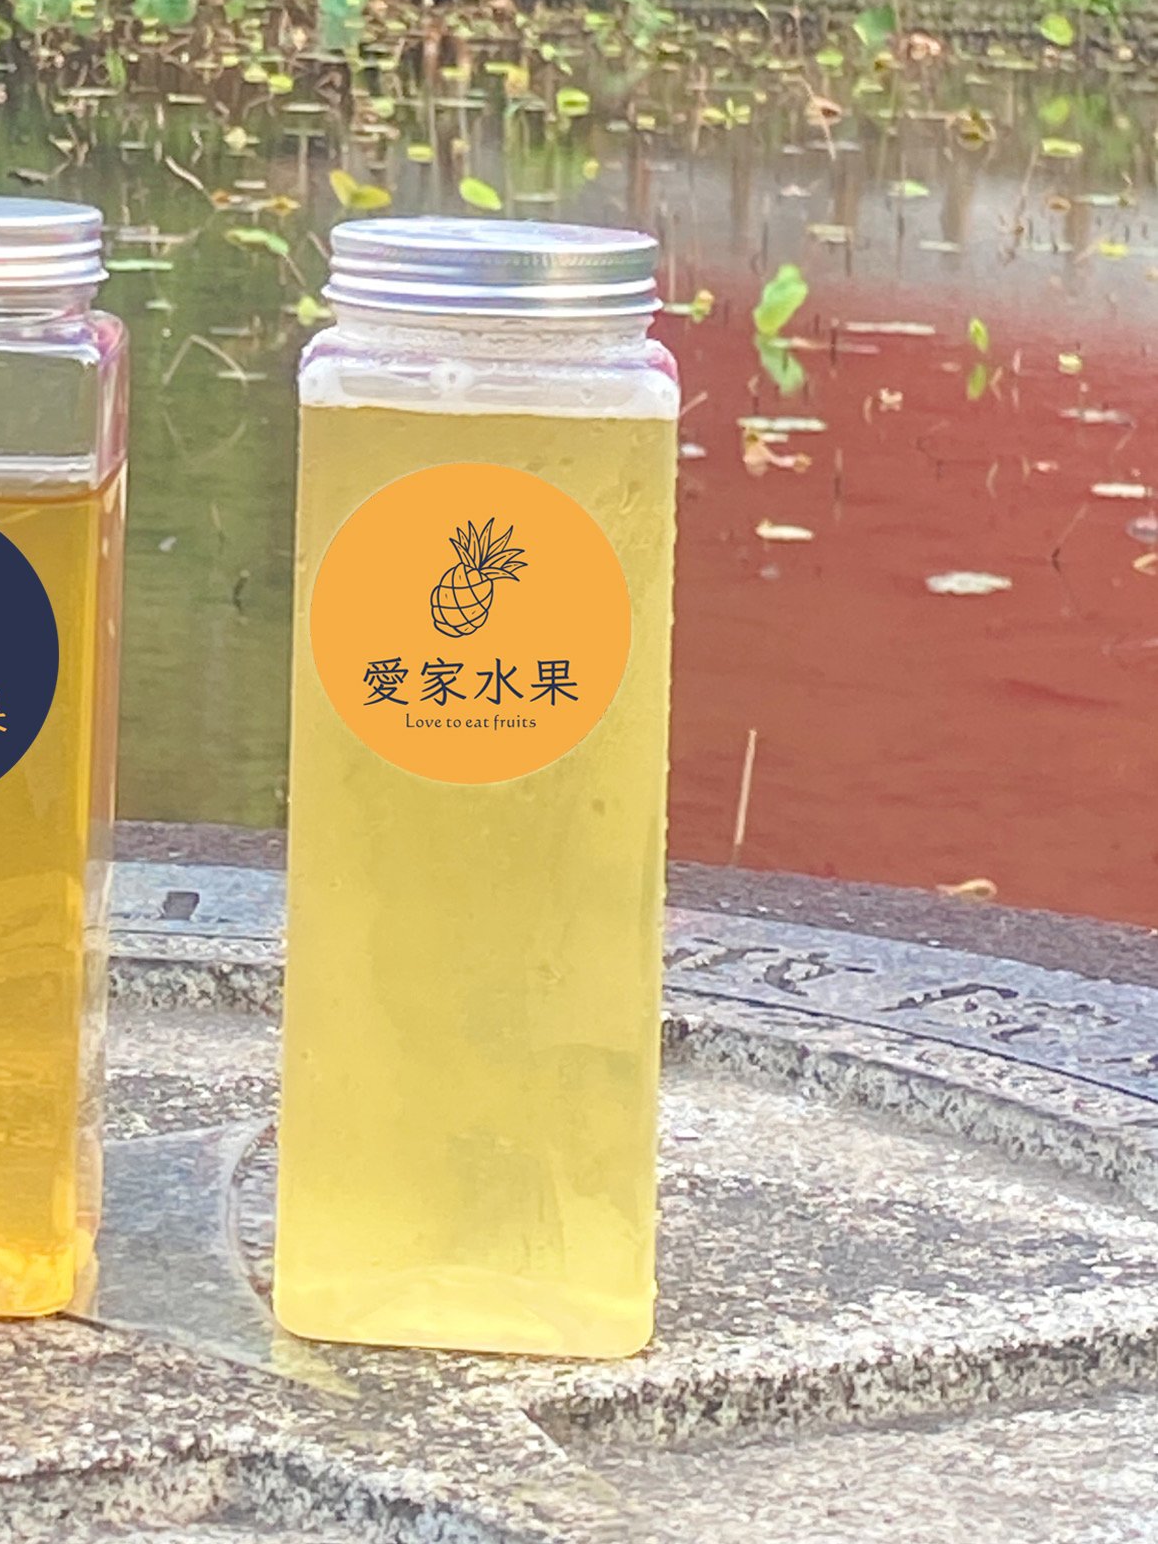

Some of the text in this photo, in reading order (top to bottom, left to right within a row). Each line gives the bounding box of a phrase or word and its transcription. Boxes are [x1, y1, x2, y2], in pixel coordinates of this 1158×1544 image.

[362, 656, 579, 707] 愛家水果
[405, 712, 537, 731] Love to eat fruits
